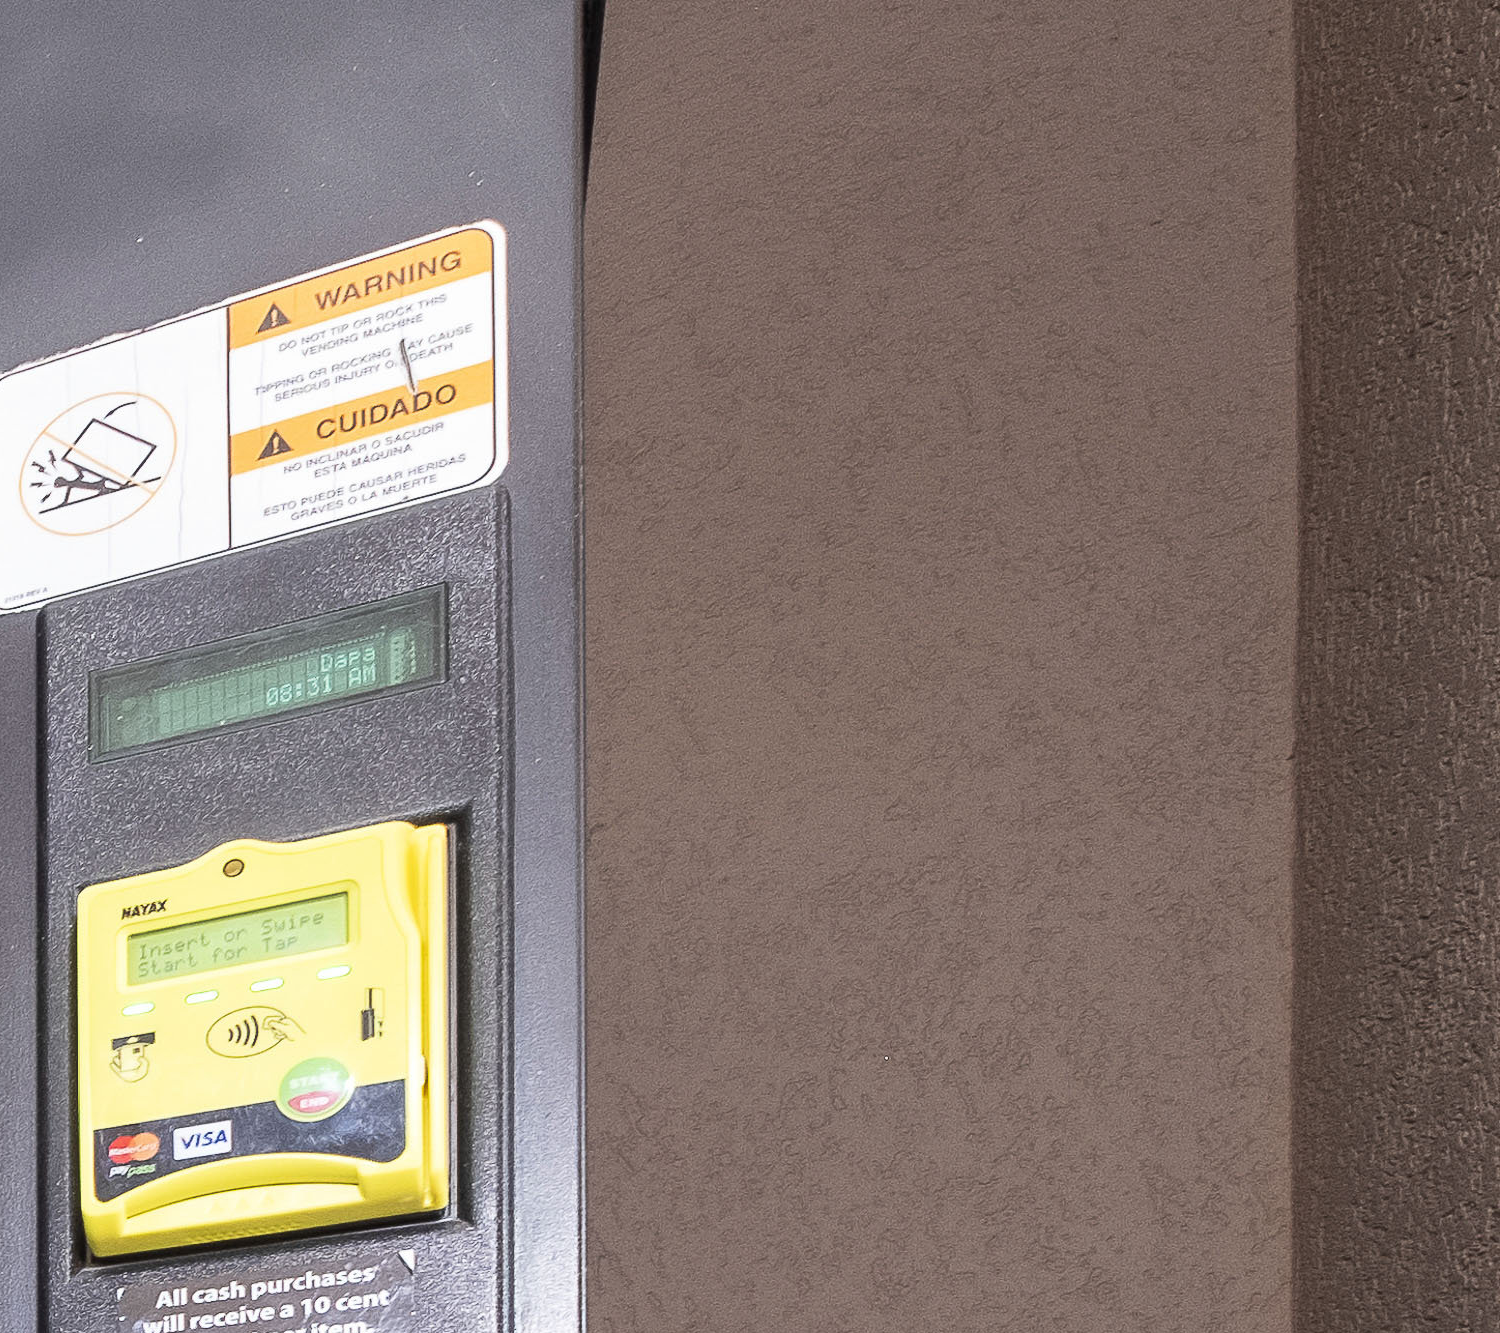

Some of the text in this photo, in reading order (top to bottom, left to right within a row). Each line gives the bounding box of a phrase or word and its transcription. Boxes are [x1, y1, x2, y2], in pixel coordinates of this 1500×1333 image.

[315, 250, 462, 311] WARNING
[279, 293, 448, 352] DO NOT TIP OR ROCK THIS
[301, 313, 424, 357] VENDING MACHINE
[255, 323, 475, 396] TIPPING OR ROCKING CAUSE
[275, 343, 454, 402] SERIOUS INJURY DEATH
[316, 384, 457, 440] CUIDADO
[283, 422, 444, 475] NO INCLINAR SACUDIR
[314, 444, 412, 478] ESTA MAQUINA
[263, 453, 466, 517] ESTO PUEDE CAUSAR HERIDAS
[290, 473, 438, 521] GRAVES LA MUERTE
[266, 666, 376, 706] 08:31 AM
[122, 900, 168, 920] NAYAX
[138, 937, 298, 977] Start for Tap
[139, 911, 324, 961] Insert or Swipe
[181, 1129, 227, 1149] VISA
[156, 1267, 375, 1309] All cash purchases
[189, 1305, 274, 1331] receive
[279, 1304, 296, 1319] a
[300, 1296, 329, 1317] 10
[334, 1289, 390, 1312] cent
